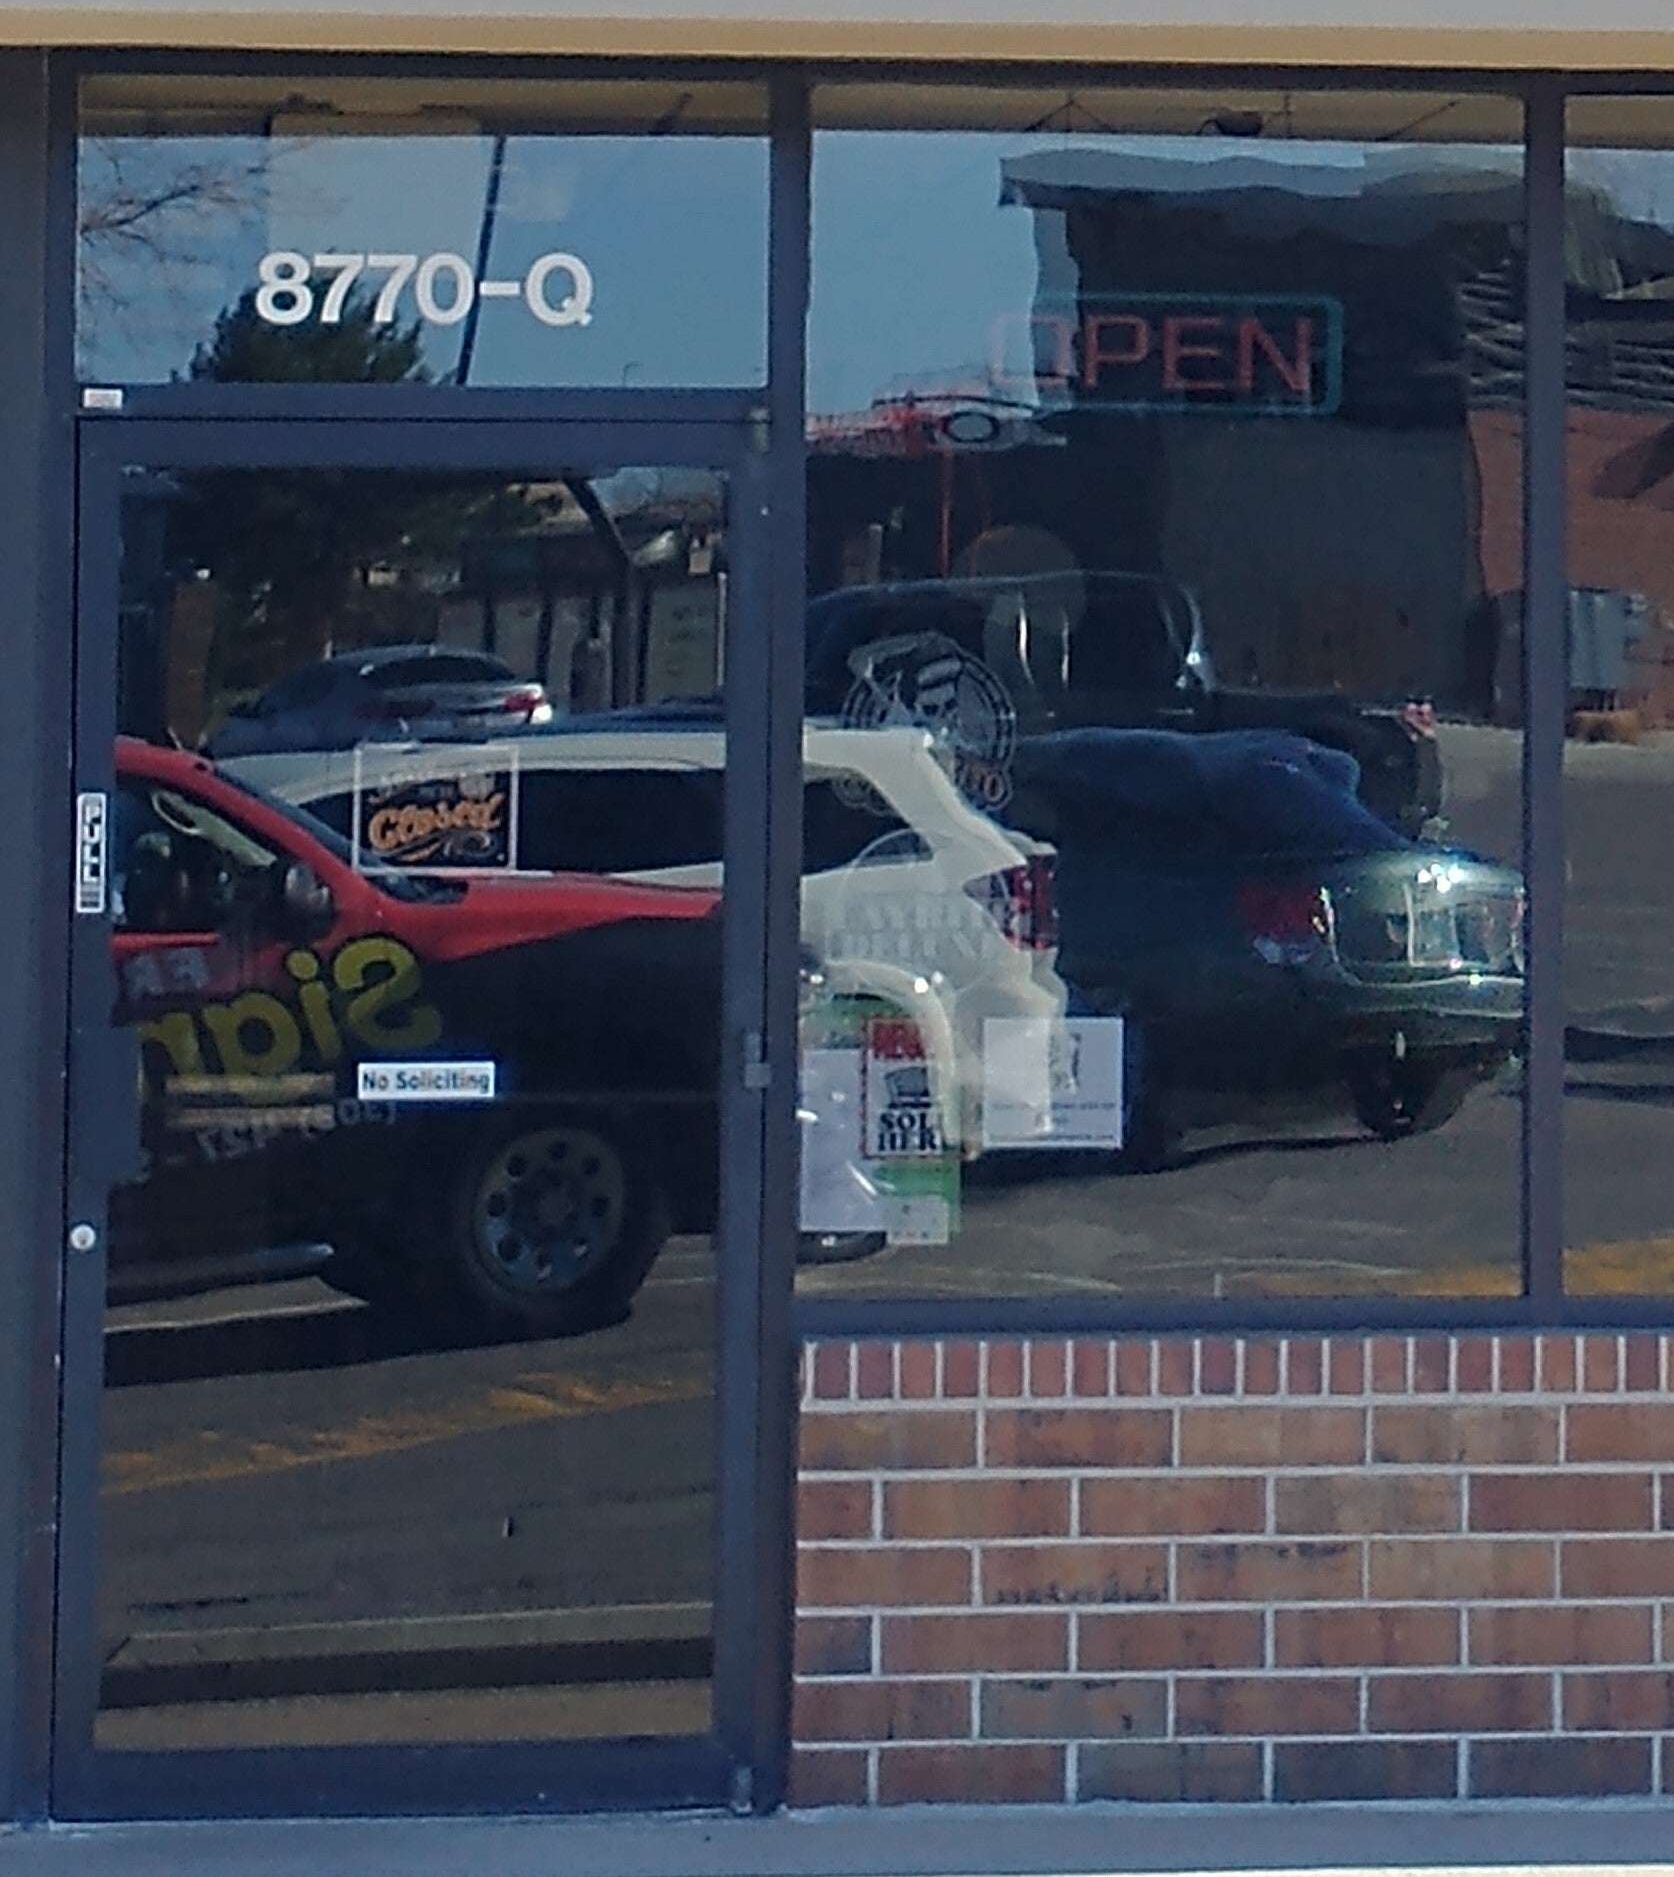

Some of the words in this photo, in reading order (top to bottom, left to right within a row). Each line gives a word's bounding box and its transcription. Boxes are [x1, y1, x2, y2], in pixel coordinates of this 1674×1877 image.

[256, 251, 594, 326] 8770-Q
[82, 804, 101, 884] PULL
[362, 1070, 390, 1091] No
[396, 1070, 491, 1095] Soliciting
